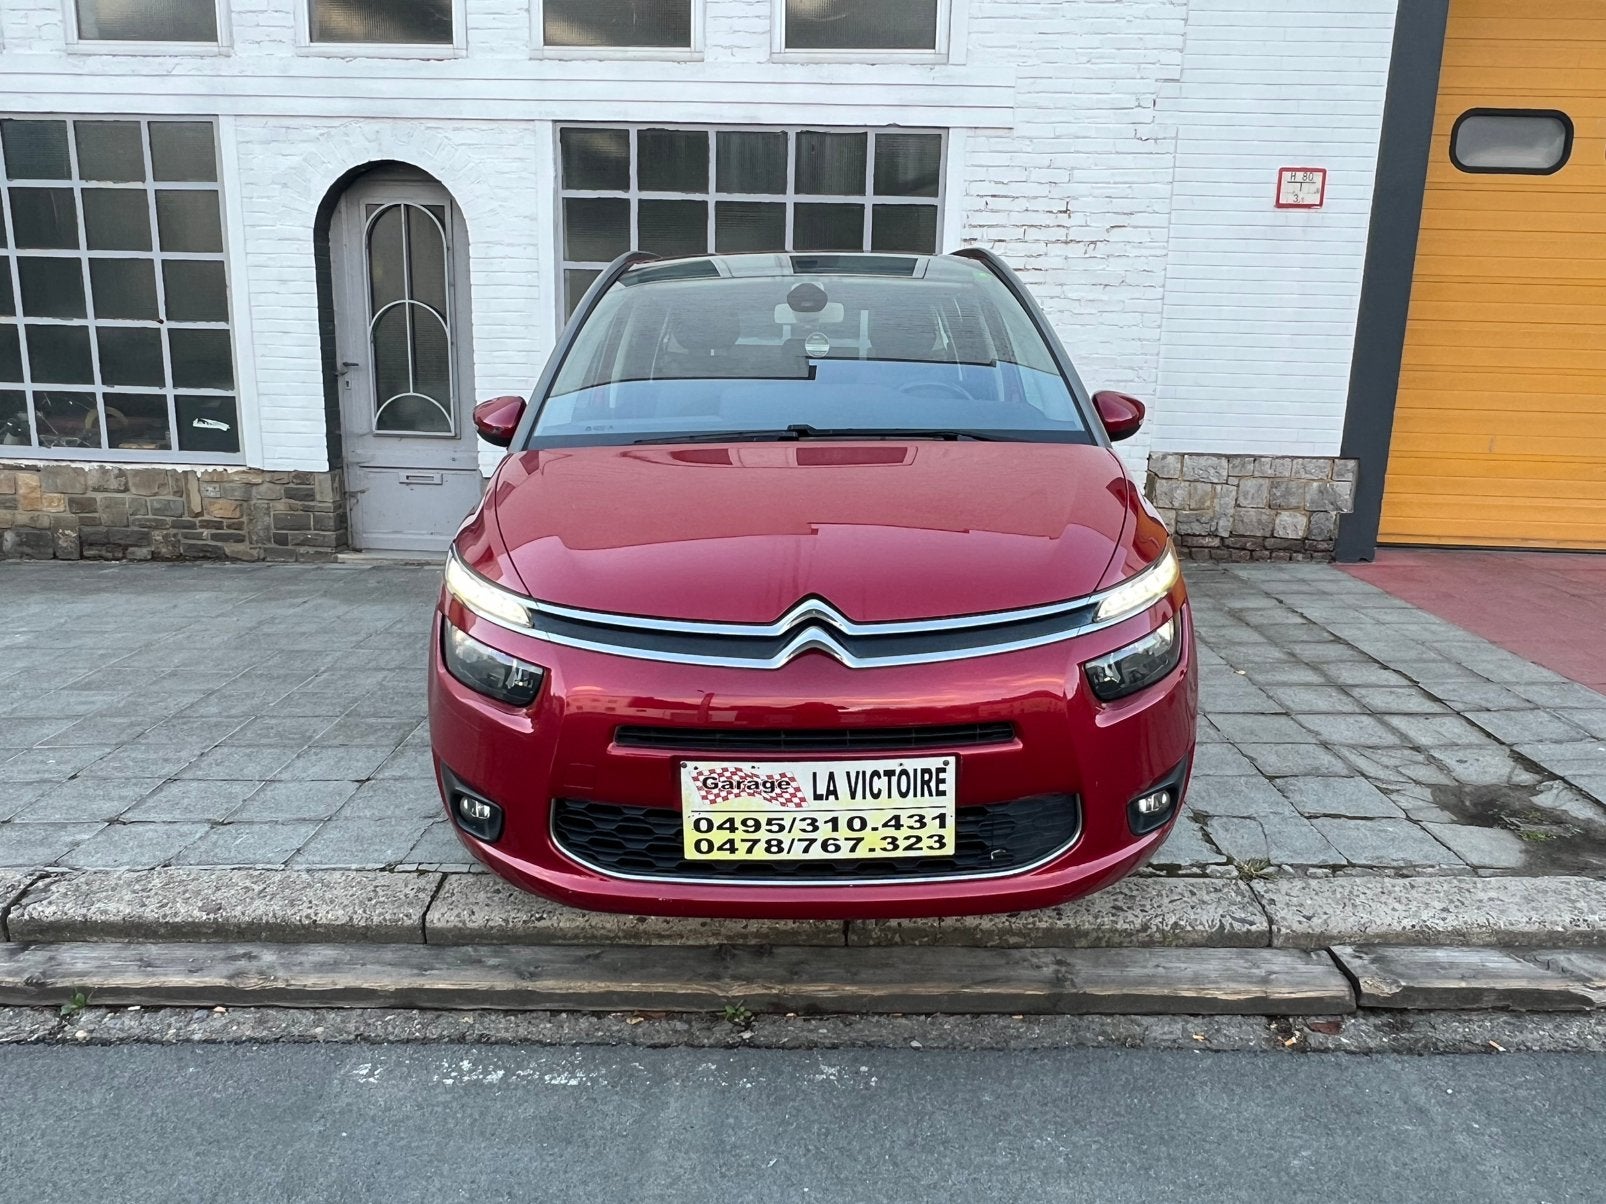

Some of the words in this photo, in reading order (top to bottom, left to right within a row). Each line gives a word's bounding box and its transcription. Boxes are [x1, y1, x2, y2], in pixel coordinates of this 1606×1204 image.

[1290, 172, 1296, 181] H
[1302, 172, 1314, 181] 80
[702, 776, 791, 793] Garage
[812, 771, 839, 801] LA
[846, 767, 947, 800] VICTOIRE
[693, 812, 947, 834] 0495/310.431
[693, 834, 947, 855] 0478/767.323
